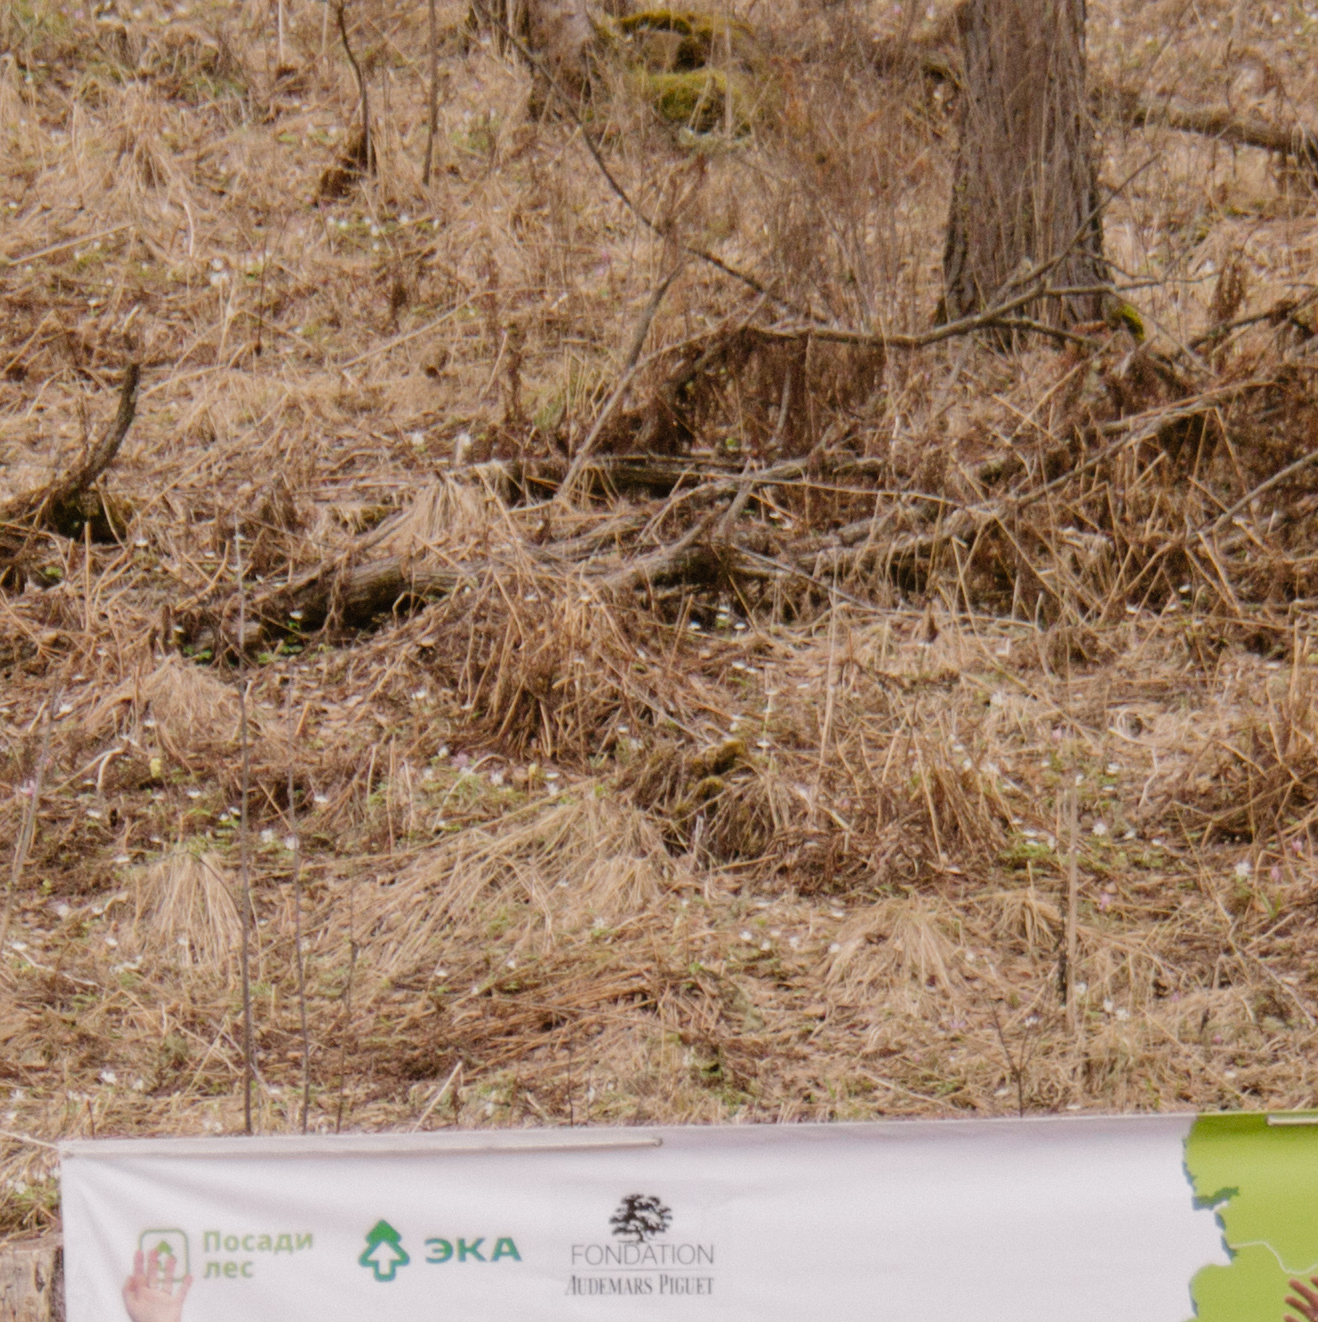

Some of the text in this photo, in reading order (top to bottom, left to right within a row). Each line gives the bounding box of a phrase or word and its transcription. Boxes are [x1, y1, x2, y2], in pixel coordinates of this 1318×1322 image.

[203, 1230, 313, 1255] Посади
[425, 1236, 522, 1263] ЭКА
[571, 1243, 715, 1266] FONDATION
[203, 1260, 254, 1279] лес
